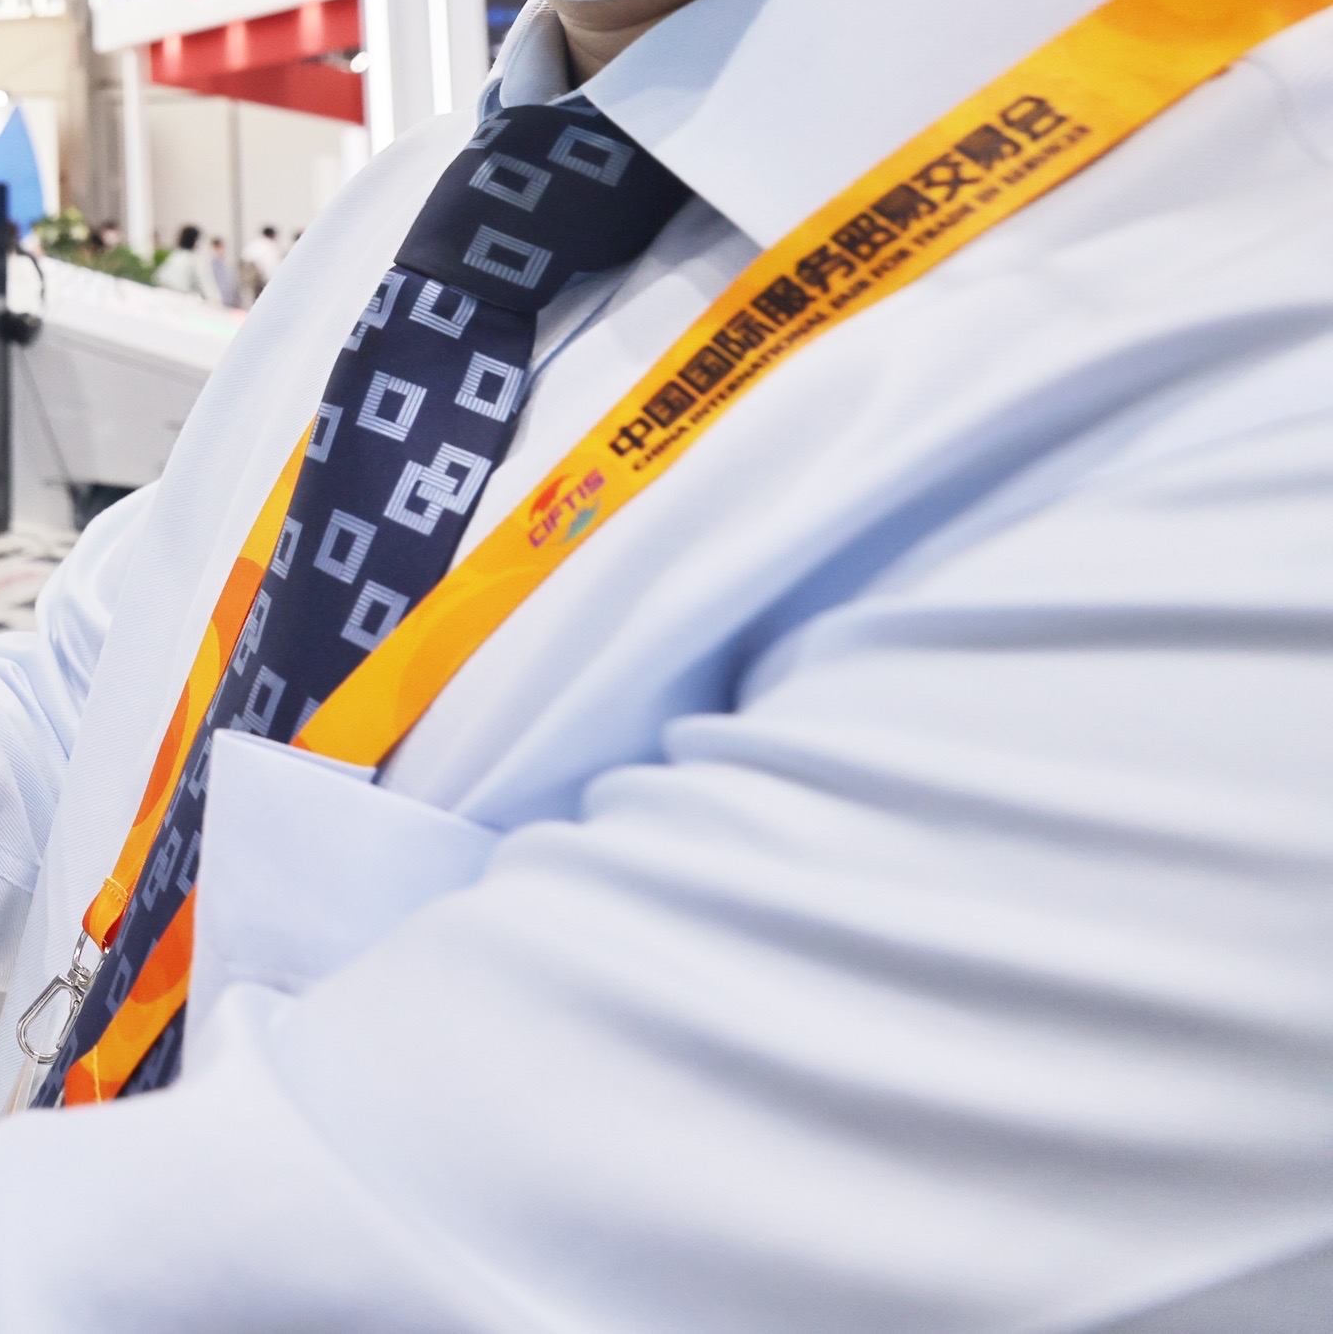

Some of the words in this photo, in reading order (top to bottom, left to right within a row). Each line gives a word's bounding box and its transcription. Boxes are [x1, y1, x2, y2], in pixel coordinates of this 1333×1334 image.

[608, 95, 1068, 457] 中国国际服务贸易交易会
[527, 468, 606, 548] CIFTIS
